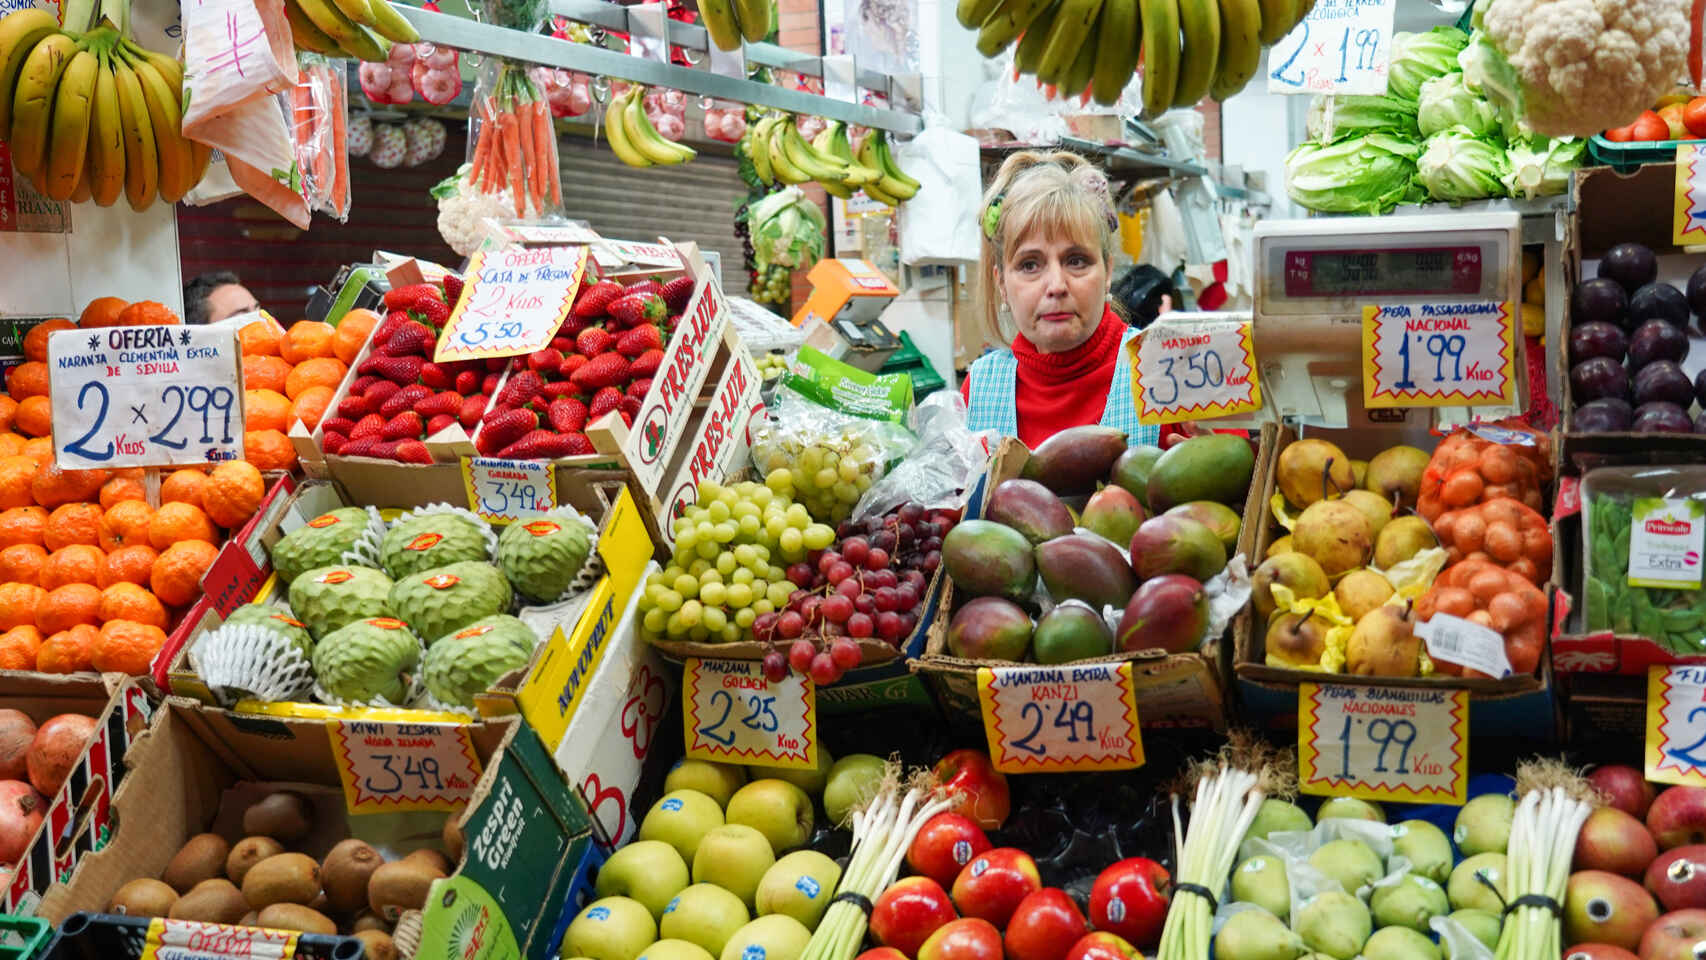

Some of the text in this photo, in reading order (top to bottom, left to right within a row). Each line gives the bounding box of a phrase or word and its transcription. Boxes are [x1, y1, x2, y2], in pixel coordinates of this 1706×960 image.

[504, 251, 555, 267] OFERTA
[473, 285, 506, 317] 2
[1382, 305, 1412, 318] PERA
[1405, 317, 1472, 332] NACIONAL
[108, 327, 175, 350] OFERTA
[660, 282, 717, 415] FRES-LUZ
[58, 348, 220, 368] NARANJA CLEMENTINA EXTRA
[106, 362, 180, 377] DE SEVILLA
[1394, 331, 1466, 389] 1'99
[1149, 349, 1225, 405] 3'50
[63, 380, 115, 461] 2
[149, 385, 234, 450] 2'99
[689, 358, 747, 487] FRES-LUZ
[482, 481, 537, 512] 3'49
[1649, 557, 1682, 569] Extra
[702, 660, 751, 675] MANZANA
[1000, 667, 1111, 687] MANZANA EXTRA
[722, 674, 768, 690] GOLDEN
[1031, 684, 1079, 701] KANZI
[1322, 685, 1357, 699] PERAS
[699, 690, 778, 745] 2'25
[1342, 701, 1417, 717] NACIONALES
[350, 722, 384, 736] KIWI
[1010, 701, 1097, 755] 2'49
[1334, 716, 1417, 780] 1'99
[366, 754, 444, 793] 3'49
[473, 776, 513, 862] Zespri
[487, 797, 524, 870] Green
